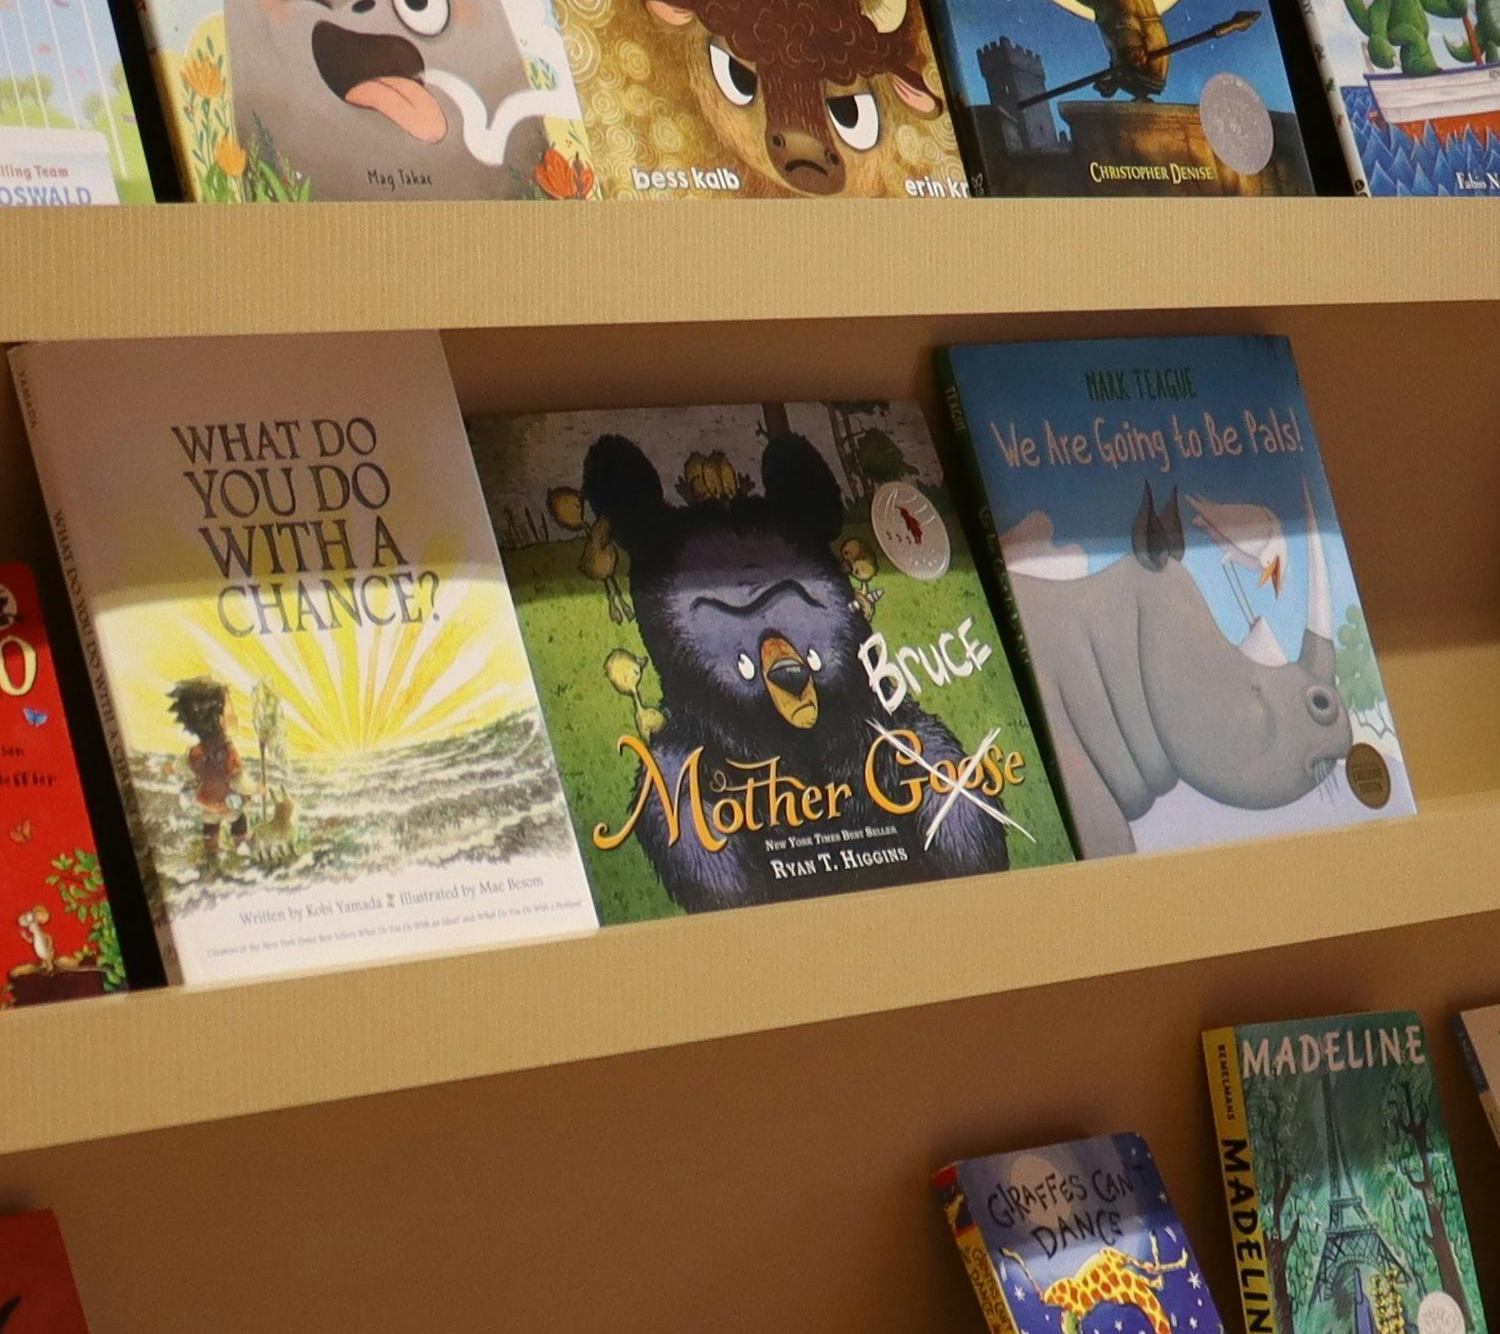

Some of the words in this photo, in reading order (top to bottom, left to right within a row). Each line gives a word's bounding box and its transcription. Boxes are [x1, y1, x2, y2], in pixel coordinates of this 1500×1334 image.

[33, 164, 70, 180] Team
[366, 168, 397, 193] Mag
[630, 167, 690, 192] bess
[691, 167, 741, 193] kalb
[1088, 161, 1170, 184] CHRISTOPHER
[1455, 171, 1487, 191] Fabio
[1083, 369, 1128, 404] MARK
[1131, 366, 1198, 402] TEAGUE
[170, 418, 305, 466] WHAT
[310, 416, 379, 459] DO
[989, 420, 1042, 469] We
[1043, 417, 1093, 467] Are
[1094, 415, 1171, 474] Going
[1170, 412, 1204, 459] to
[1204, 410, 1243, 457] Be
[1243, 406, 1306, 455] Pals!
[182, 466, 298, 519] YOU
[313, 460, 393, 513] DO
[198, 515, 363, 579] WITH
[372, 515, 410, 568] A
[216, 569, 442, 639] CHANCE?
[592, 734, 854, 854] Mother
[764, 839, 788, 852] NEW
[787, 834, 814, 849] YORK
[817, 851, 840, 873] T.
[239, 907, 287, 927] Written
[289, 905, 305, 924] by
[306, 899, 335, 920] Kobi
[336, 894, 384, 916] Yamada
[398, 886, 460, 908] Illustrated
[461, 883, 477, 904] by
[508, 874, 545, 894] Besom
[1241, 1024, 1428, 1080] MADELINE
[986, 1171, 1090, 1230] GIRAFFES
[1089, 1168, 1135, 1206] CAN
[1033, 1209, 1124, 1260] DANCE
